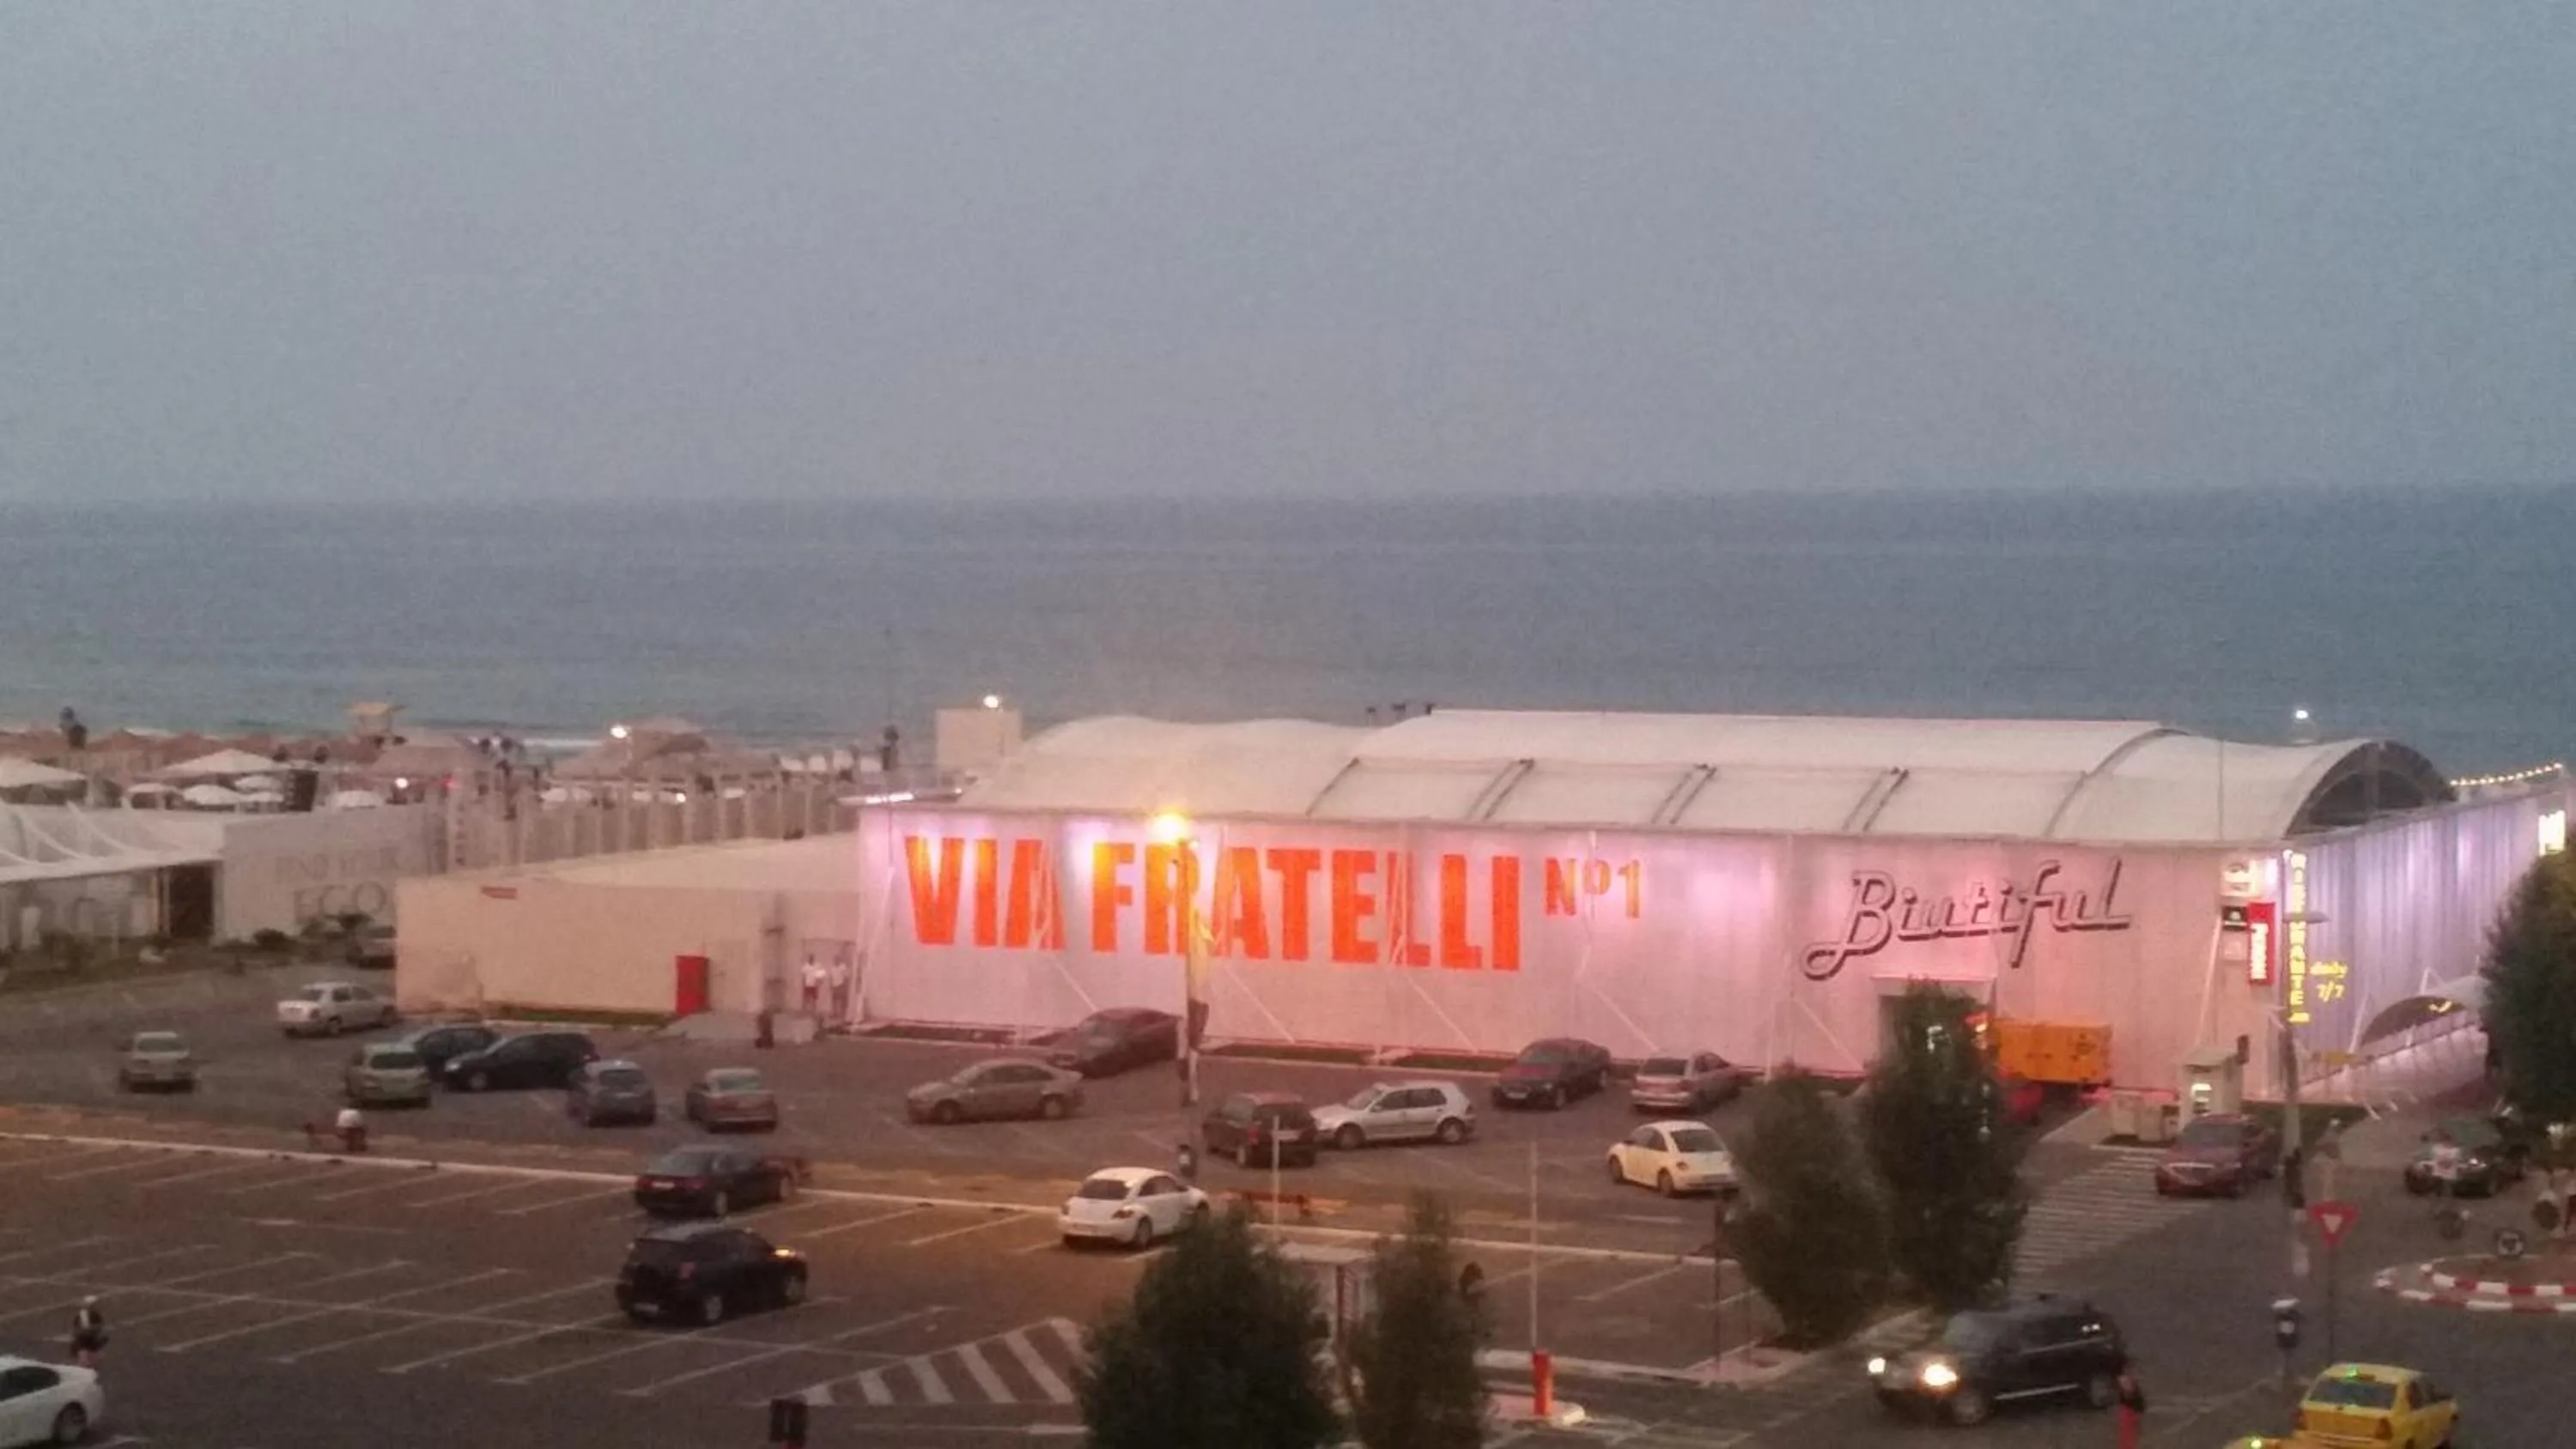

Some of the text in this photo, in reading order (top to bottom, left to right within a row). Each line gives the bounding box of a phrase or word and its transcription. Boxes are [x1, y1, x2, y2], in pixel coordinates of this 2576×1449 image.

[904, 835, 1065, 949] VIA
[1091, 841, 1521, 971] FRATELLI
[1803, 858, 2133, 980] Biutiful
